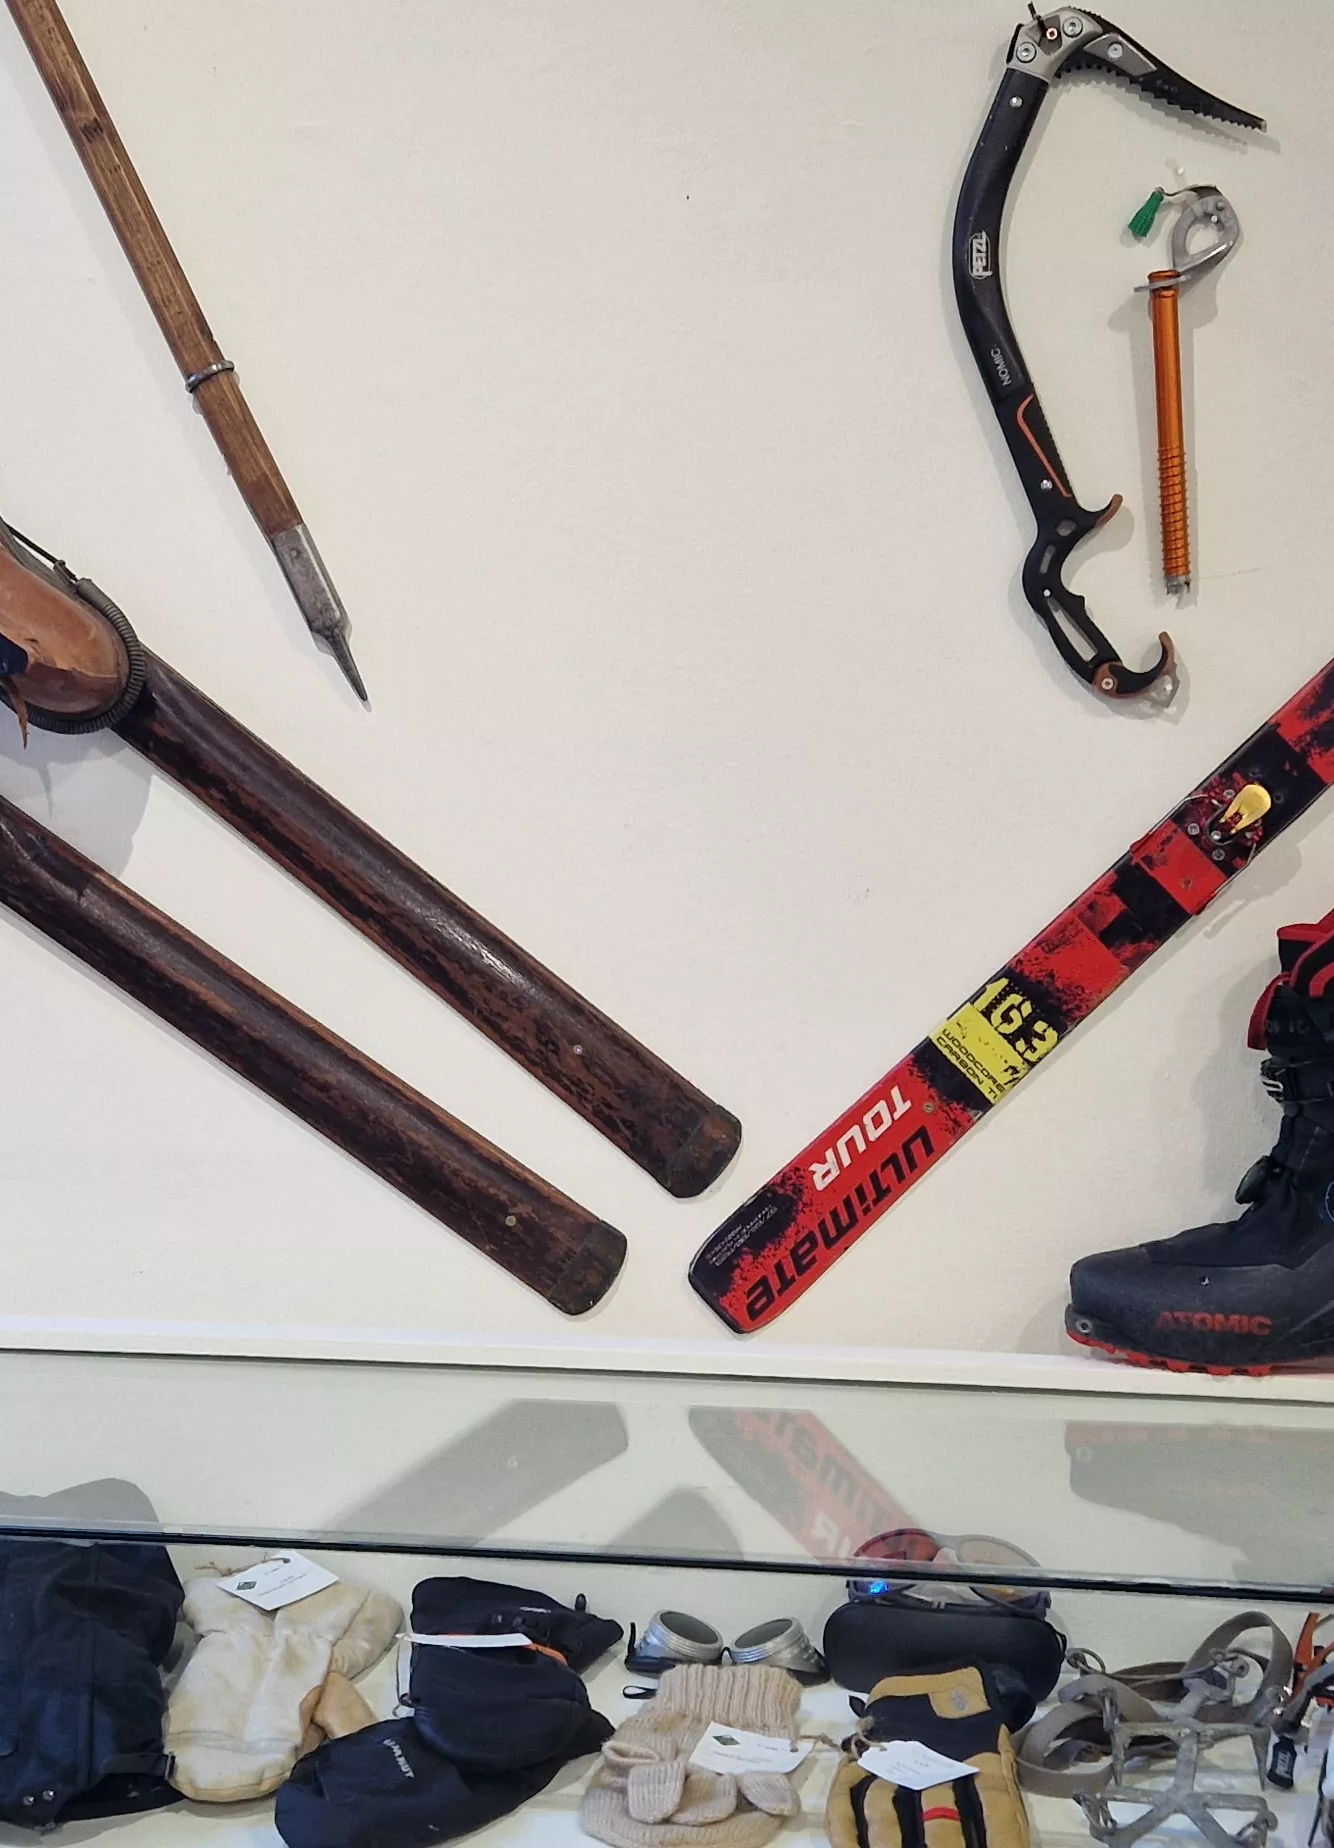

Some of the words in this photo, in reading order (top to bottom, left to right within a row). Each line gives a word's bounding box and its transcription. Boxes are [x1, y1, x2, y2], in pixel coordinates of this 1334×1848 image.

[972, 230, 993, 277] PETZL
[991, 347, 1012, 387] NOMIC
[970, 977, 1059, 1063] 163
[936, 1036, 984, 1086] CARBON
[941, 1028, 1005, 1092] WOODCORE
[809, 1085, 912, 1191] TOUR
[1155, 1311, 1272, 1335] ATOMIC
